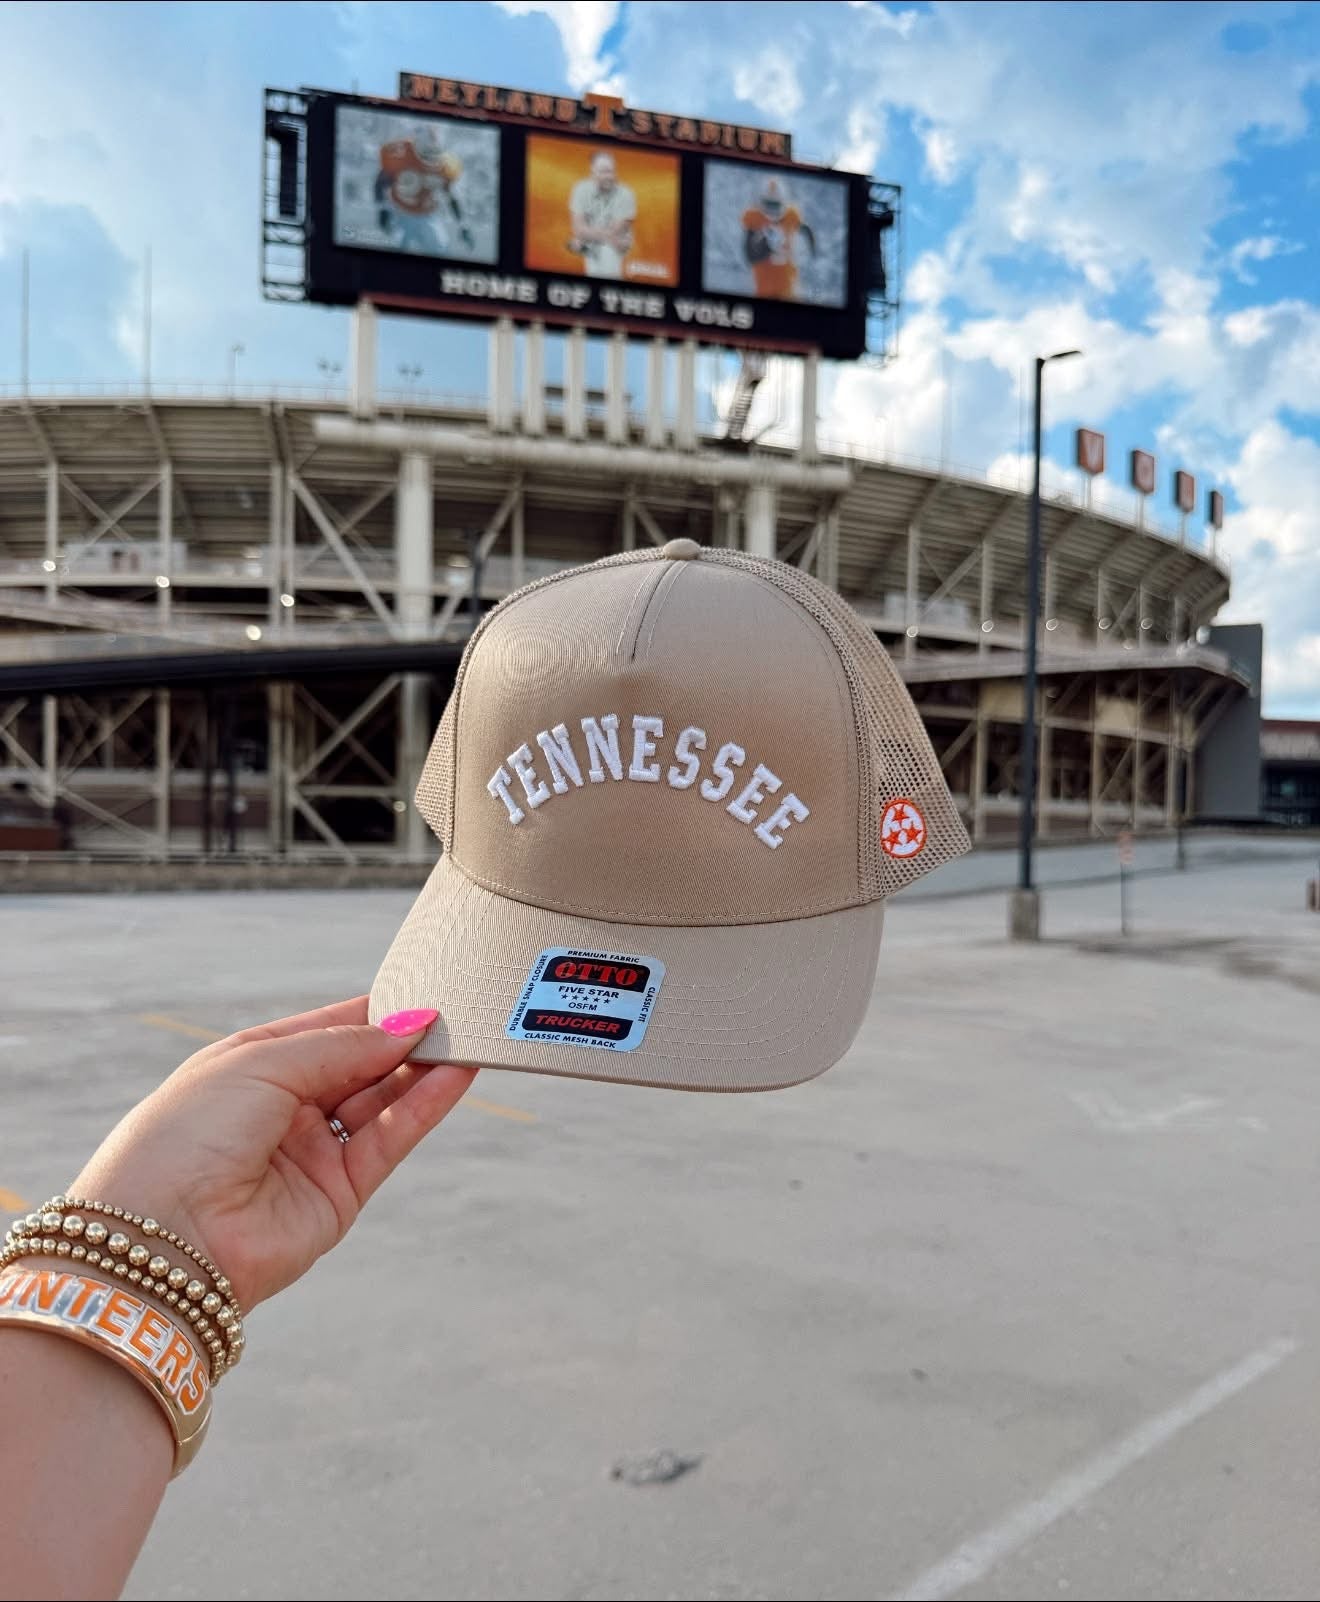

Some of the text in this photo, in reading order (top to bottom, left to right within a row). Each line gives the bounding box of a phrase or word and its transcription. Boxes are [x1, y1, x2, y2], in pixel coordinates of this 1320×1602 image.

[581, 92, 627, 135] T
[631, 111, 786, 156] STADIUM
[440, 269, 754, 330] HOME OF THE VOLS
[487, 713, 810, 849] TENNESSEE
[567, 950, 640, 964] PREMIUM FABRIC
[554, 961, 638, 986] OTTO
[509, 954, 548, 1031] DURABLE SNAP CLOSURE
[558, 985, 620, 999] FIVE STAR
[637, 986, 656, 1023] CLASSIC FIT
[568, 1001, 598, 1011] OSFM
[535, 1014, 621, 1033] TRUCKER
[524, 1032, 617, 1049] CLASSIC MESH BACK
